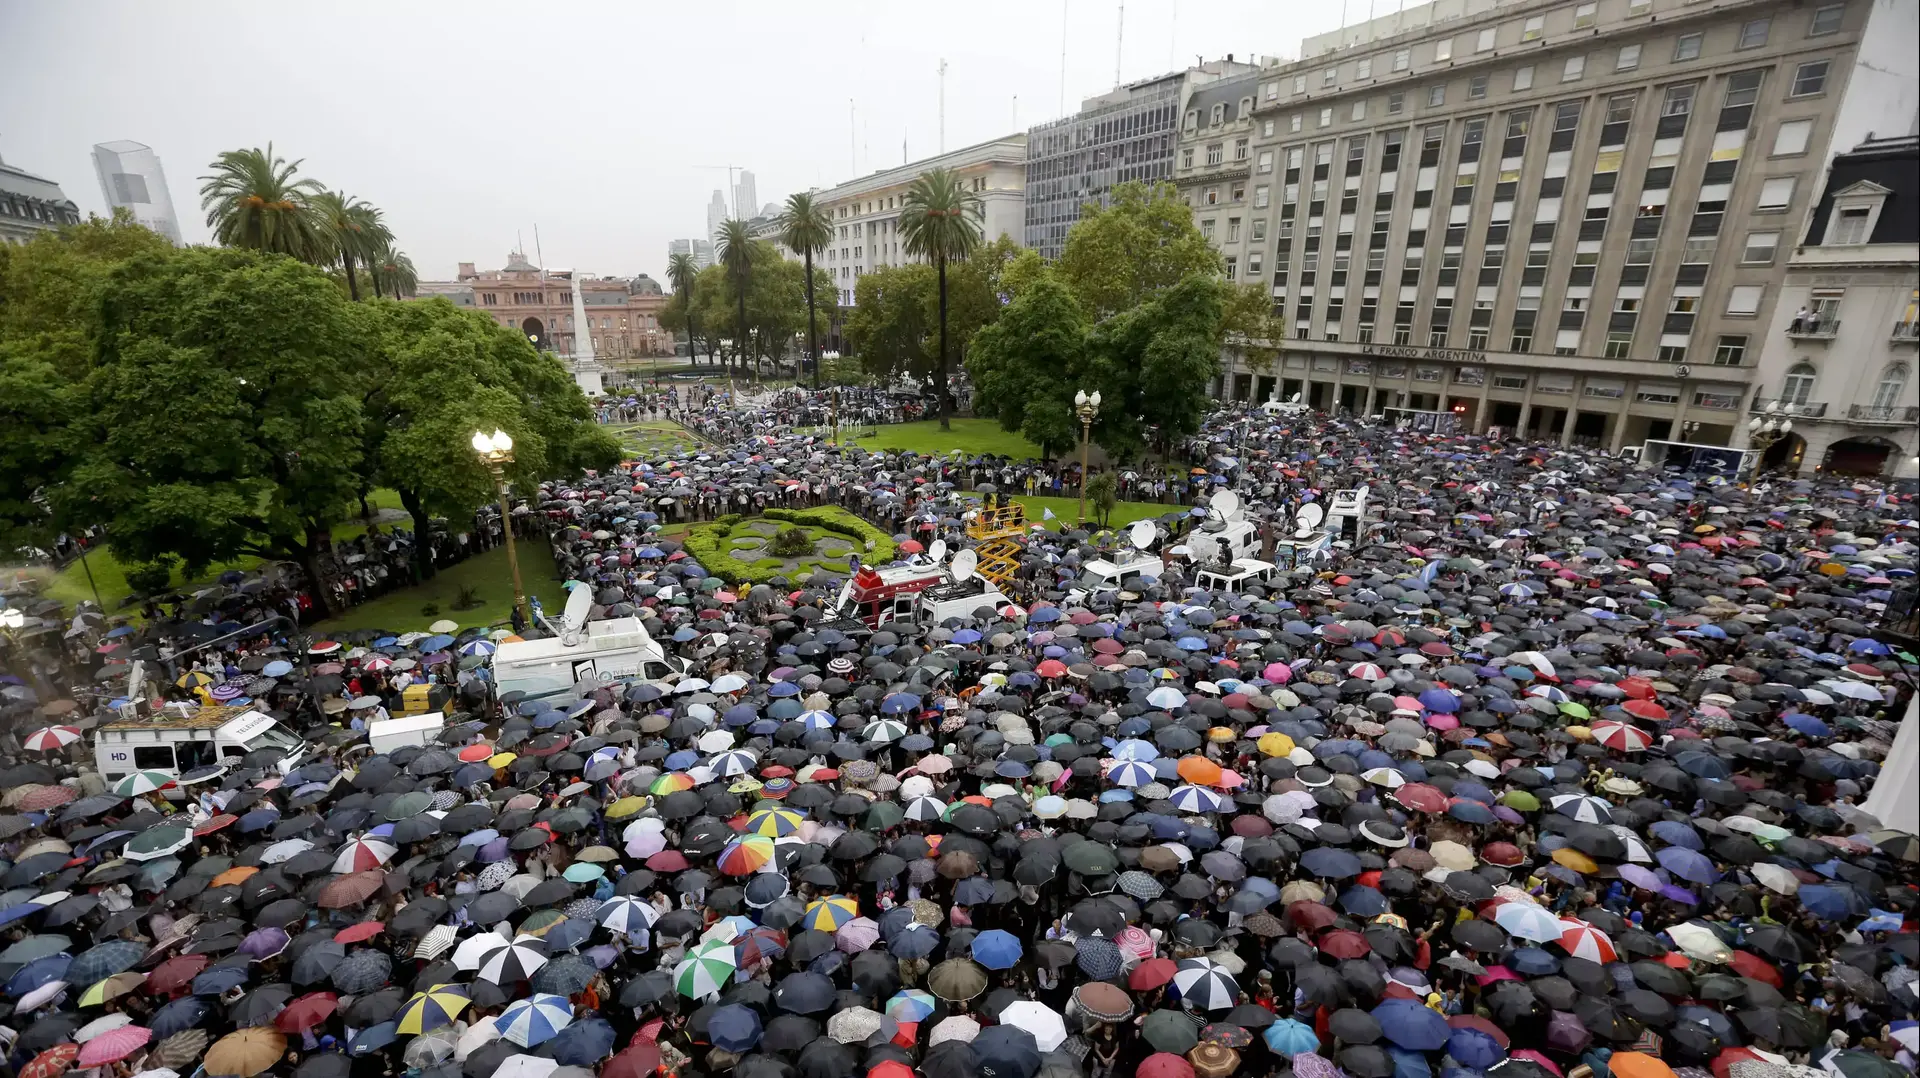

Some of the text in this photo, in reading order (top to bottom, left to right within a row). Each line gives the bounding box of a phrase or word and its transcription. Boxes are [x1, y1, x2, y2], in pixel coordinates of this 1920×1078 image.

[1362, 346, 1487, 362] LA FRANCO ARGENTINA
[111, 752, 127, 761] HD
